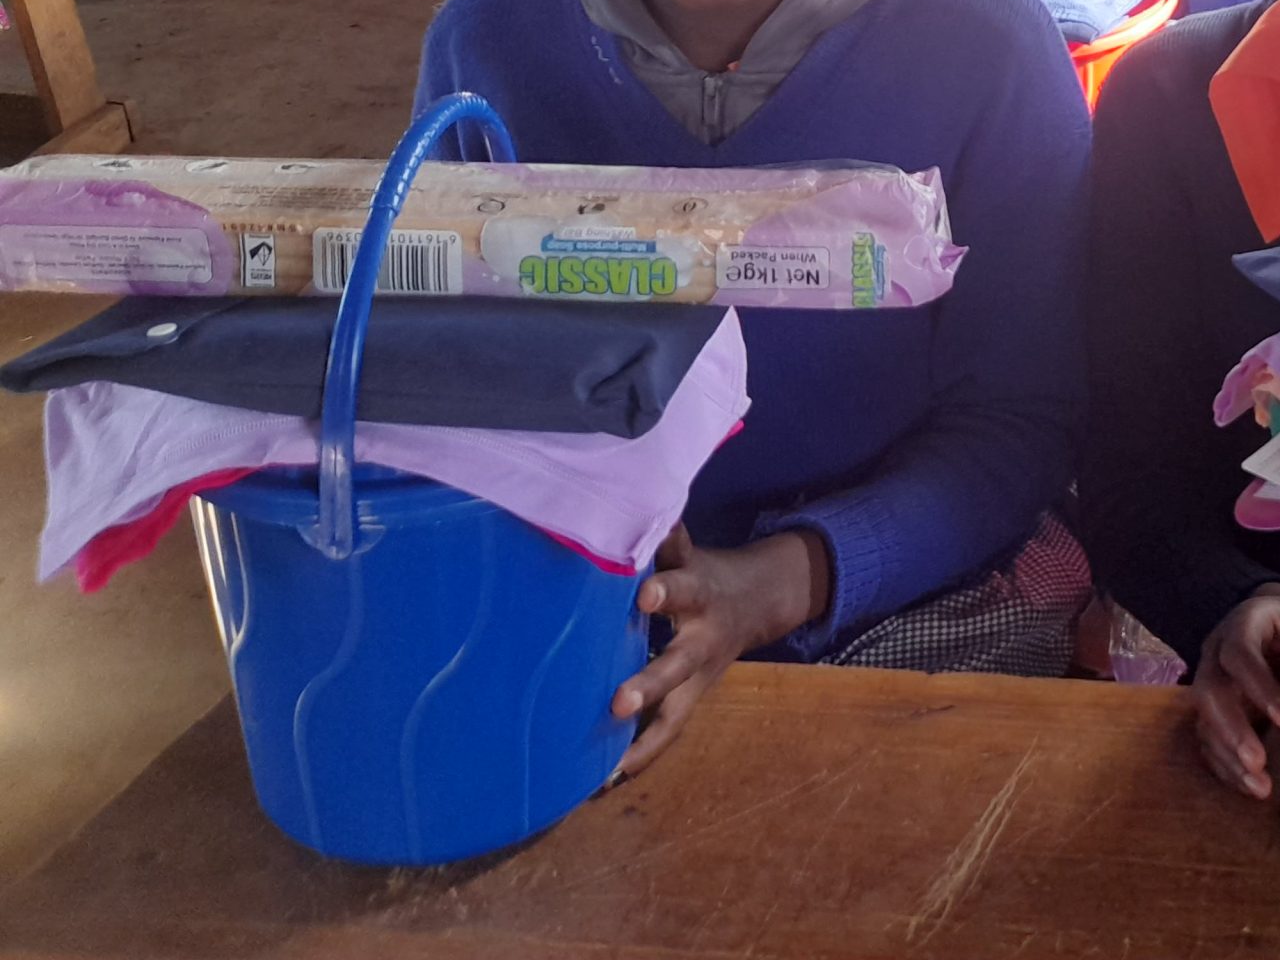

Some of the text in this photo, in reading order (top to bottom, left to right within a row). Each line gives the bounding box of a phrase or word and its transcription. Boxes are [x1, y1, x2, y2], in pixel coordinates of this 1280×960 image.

[730, 250, 817, 263] When Packed
[519, 255, 678, 295] CLASSIC
[787, 266, 821, 286] Net
